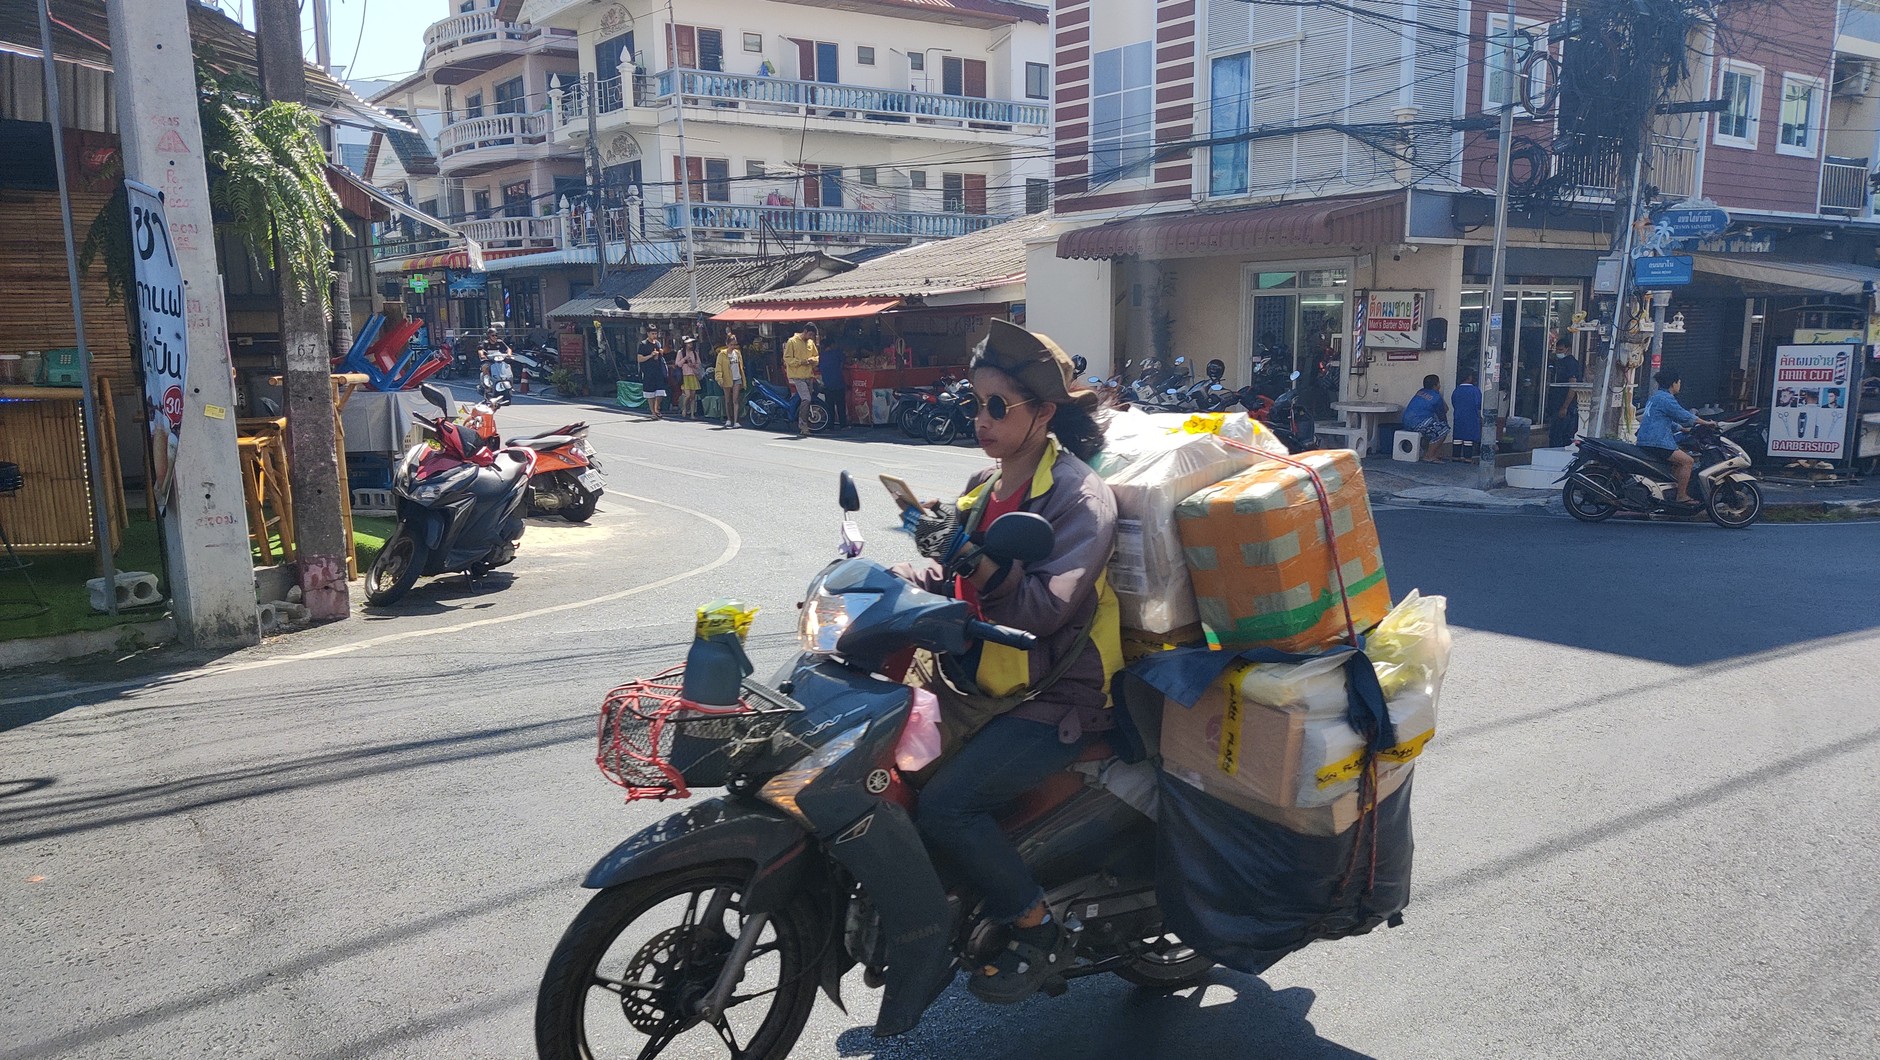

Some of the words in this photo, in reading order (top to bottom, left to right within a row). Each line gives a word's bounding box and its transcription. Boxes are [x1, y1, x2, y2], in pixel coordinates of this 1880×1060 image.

[133, 206, 174, 268] ชา
[137, 281, 182, 318] กาแฟ
[1370, 294, 1412, 317] ตัดผมชาย
[1369, 320, 1382, 329] Men's
[1382, 320, 1398, 329] Barber
[1398, 320, 1410, 331] Shop
[297, 344, 316, 357] 67
[1780, 354, 1834, 366] ตัดผมชาย
[1780, 369, 1807, 380] HAIR
[1809, 370, 1833, 380] CUT
[1771, 440, 1840, 453] BARBERSHOP
[1222, 731, 1235, 773] FLASH
